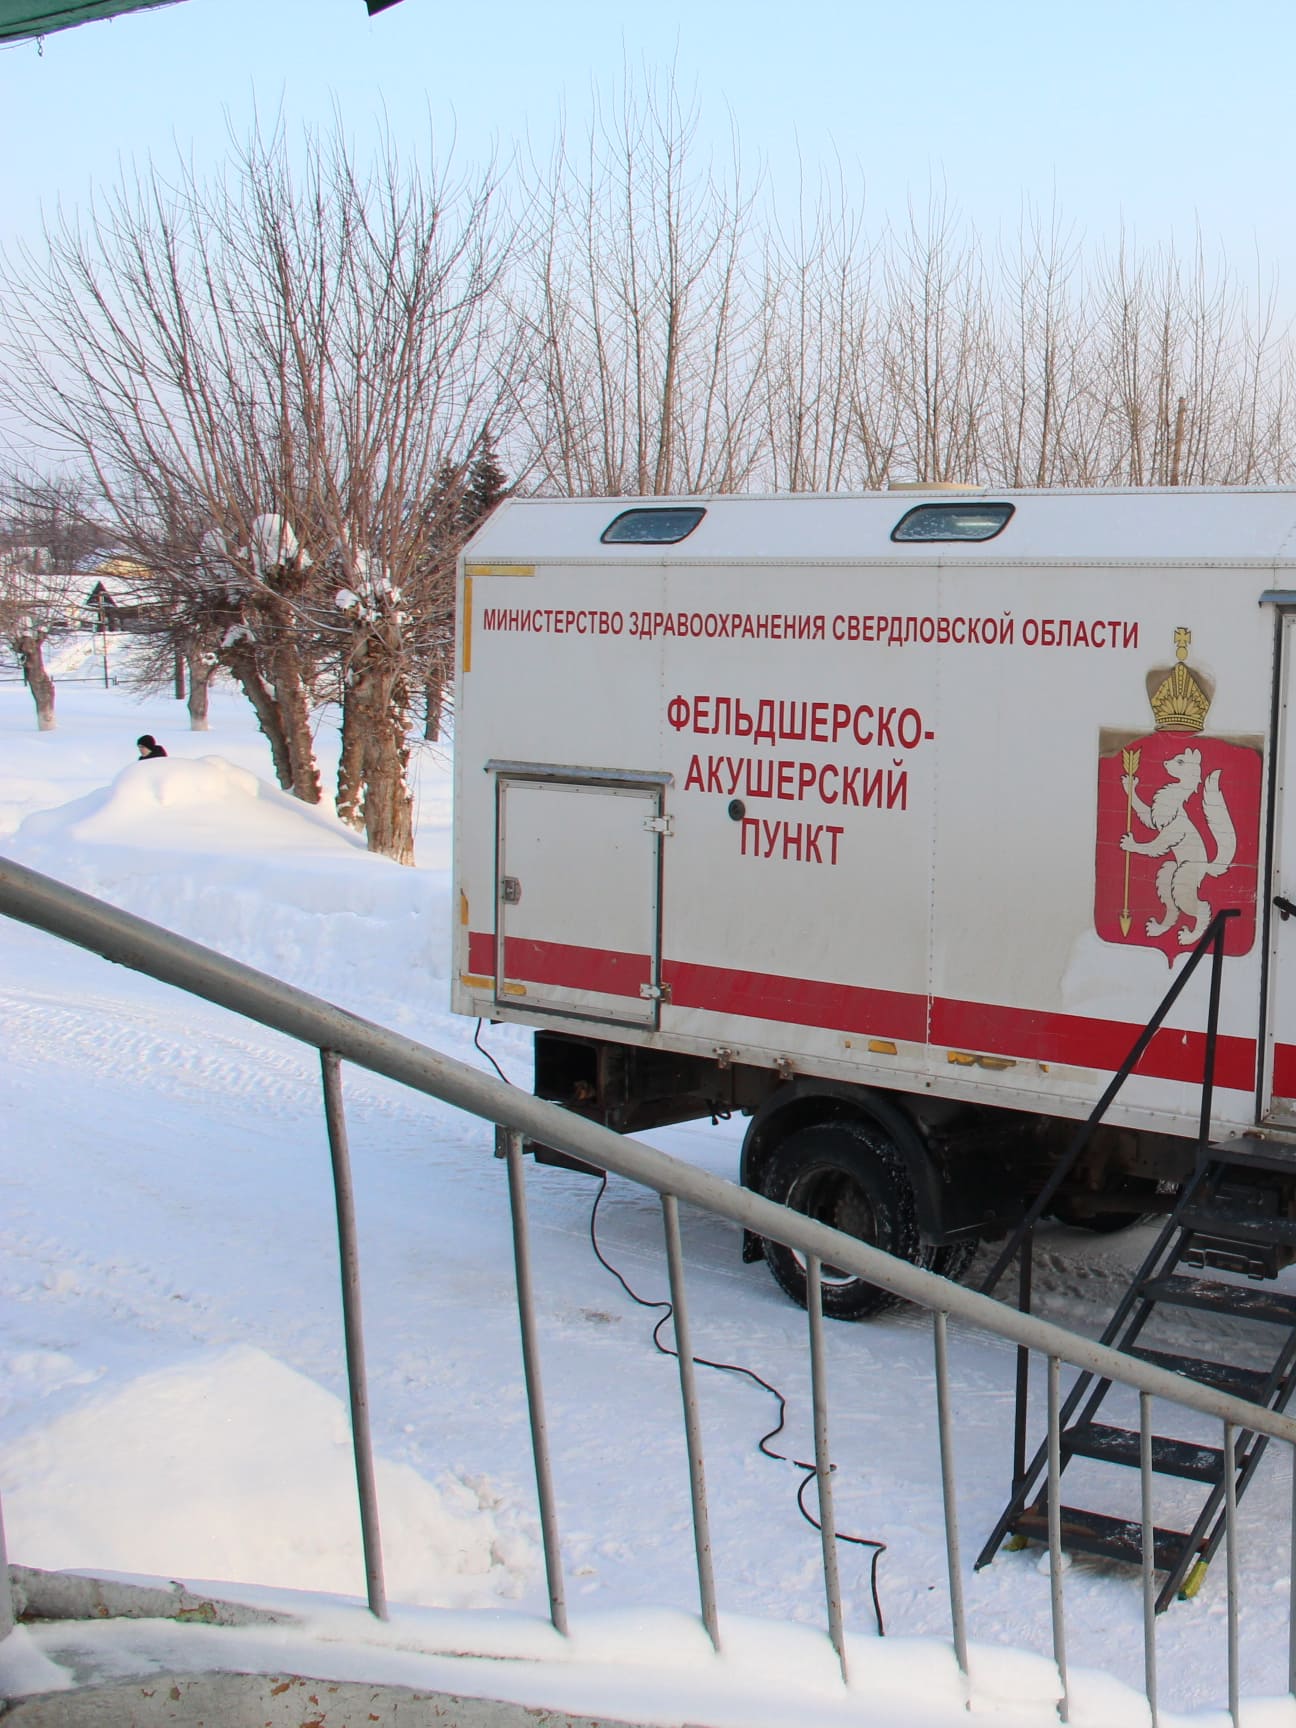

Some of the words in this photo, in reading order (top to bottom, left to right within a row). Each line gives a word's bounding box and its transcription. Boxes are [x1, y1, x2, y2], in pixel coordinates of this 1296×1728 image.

[483, 609, 624, 636] МИНИСТЕРСТВО
[628, 611, 826, 641] ЗДРАВООХРАНЕНИЯ
[832, 610, 1015, 647] СВЕРДЛОВСКОЙ
[1022, 619, 1140, 649] ОБЛАСТИ
[667, 694, 936, 751] ФЕЛЬДШЕРСКО-
[684, 754, 909, 811] АКУШЕРСКИЙ
[740, 816, 845, 866] ПУНКТ
